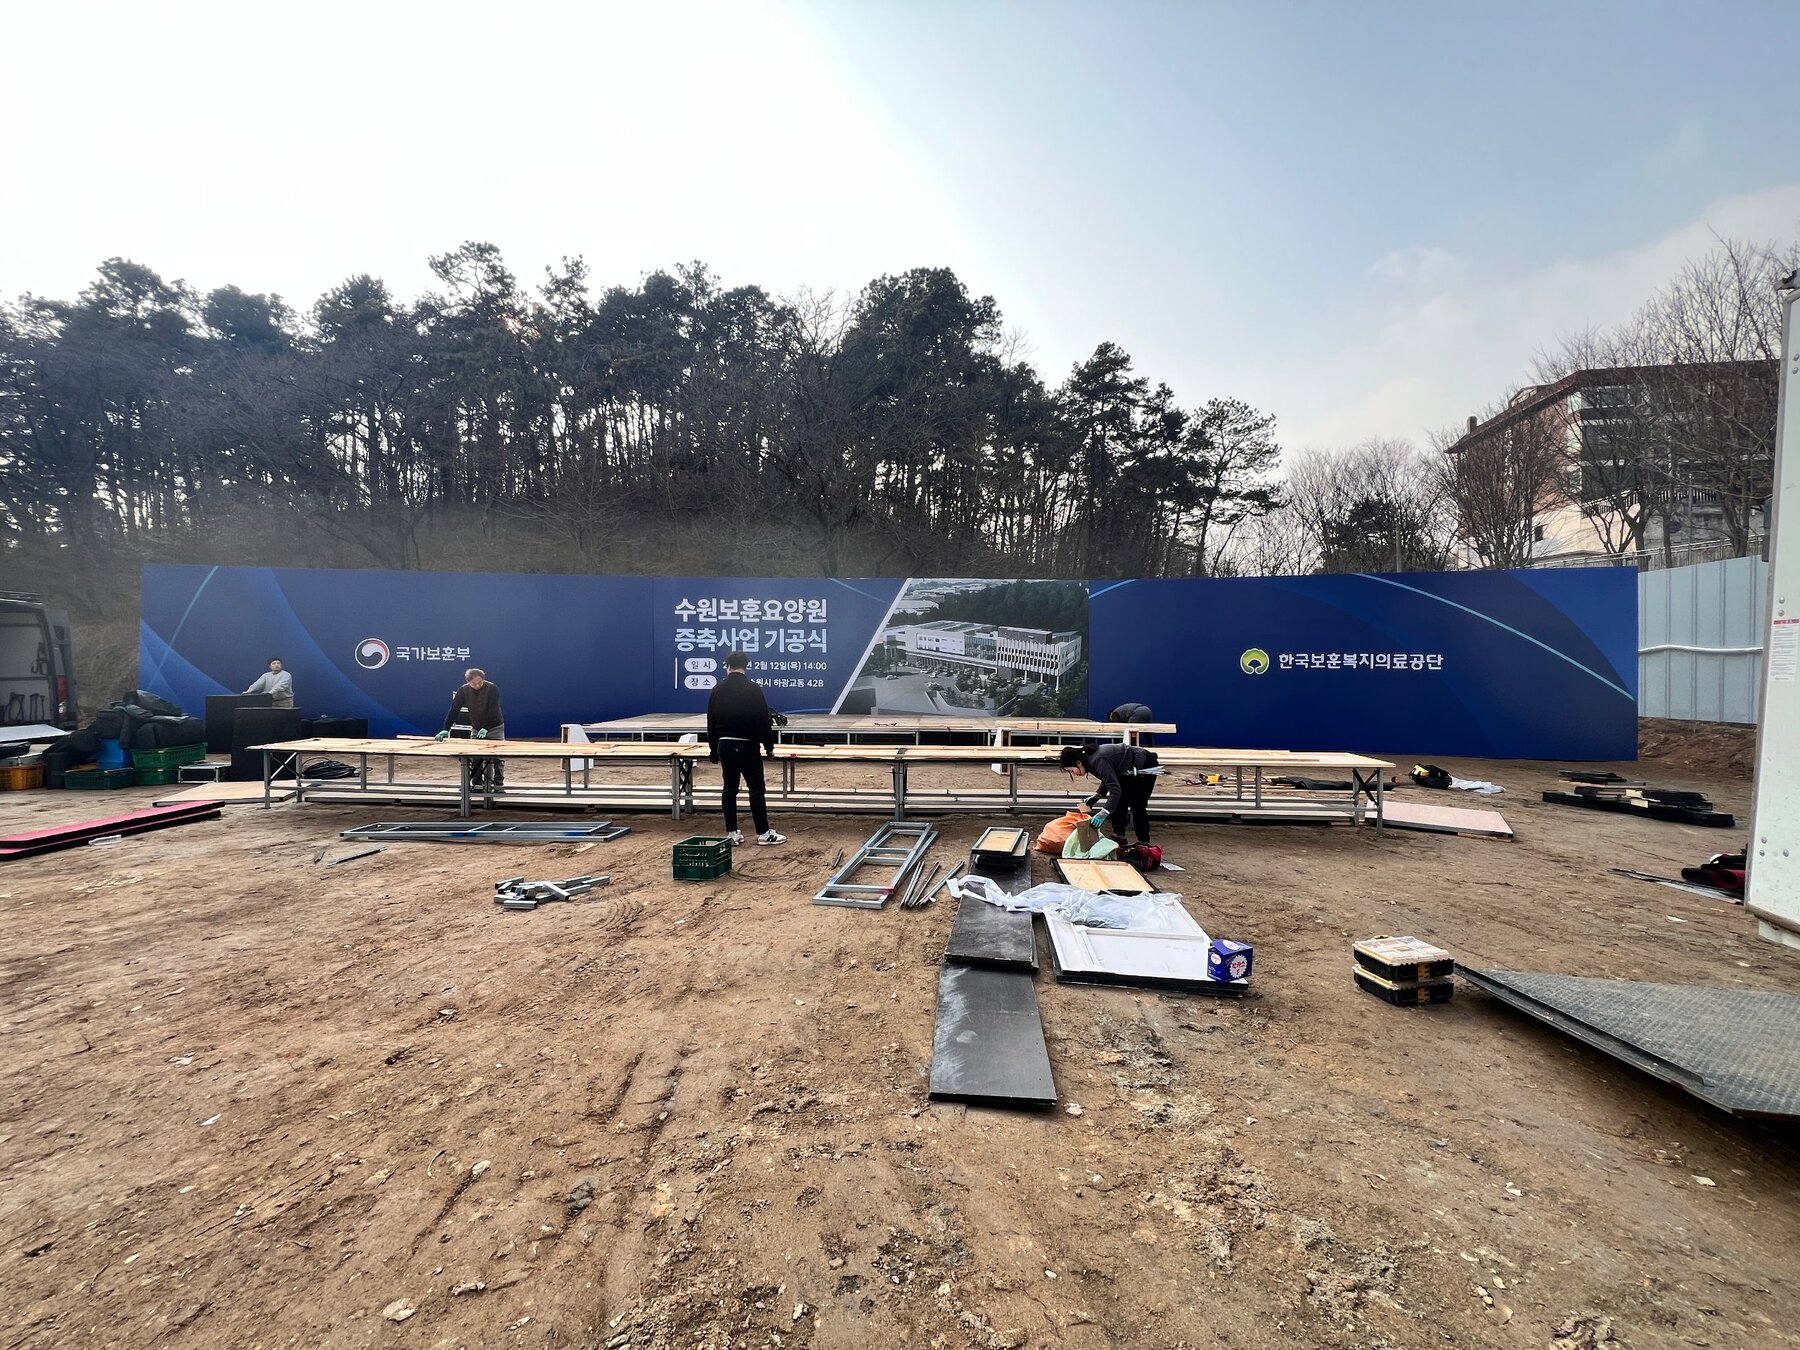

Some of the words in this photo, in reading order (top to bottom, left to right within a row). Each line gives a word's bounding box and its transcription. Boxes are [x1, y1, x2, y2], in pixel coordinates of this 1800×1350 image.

[674, 598, 828, 623] 수원보훈요양원
[674, 628, 760, 653] 증축사업
[764, 628, 828, 653] 기공식
[396, 646, 471, 661] 국가보훈부
[1278, 653, 1444, 670] 한국보훈복지의료공단
[754, 661, 768, 671] 2월
[769, 661, 802, 671] 12일(목)
[803, 661, 827, 670] 14:00
[750, 678, 772, 688] 원시
[773, 678, 805, 688] 하광교동
[806, 679, 824, 688] 428
